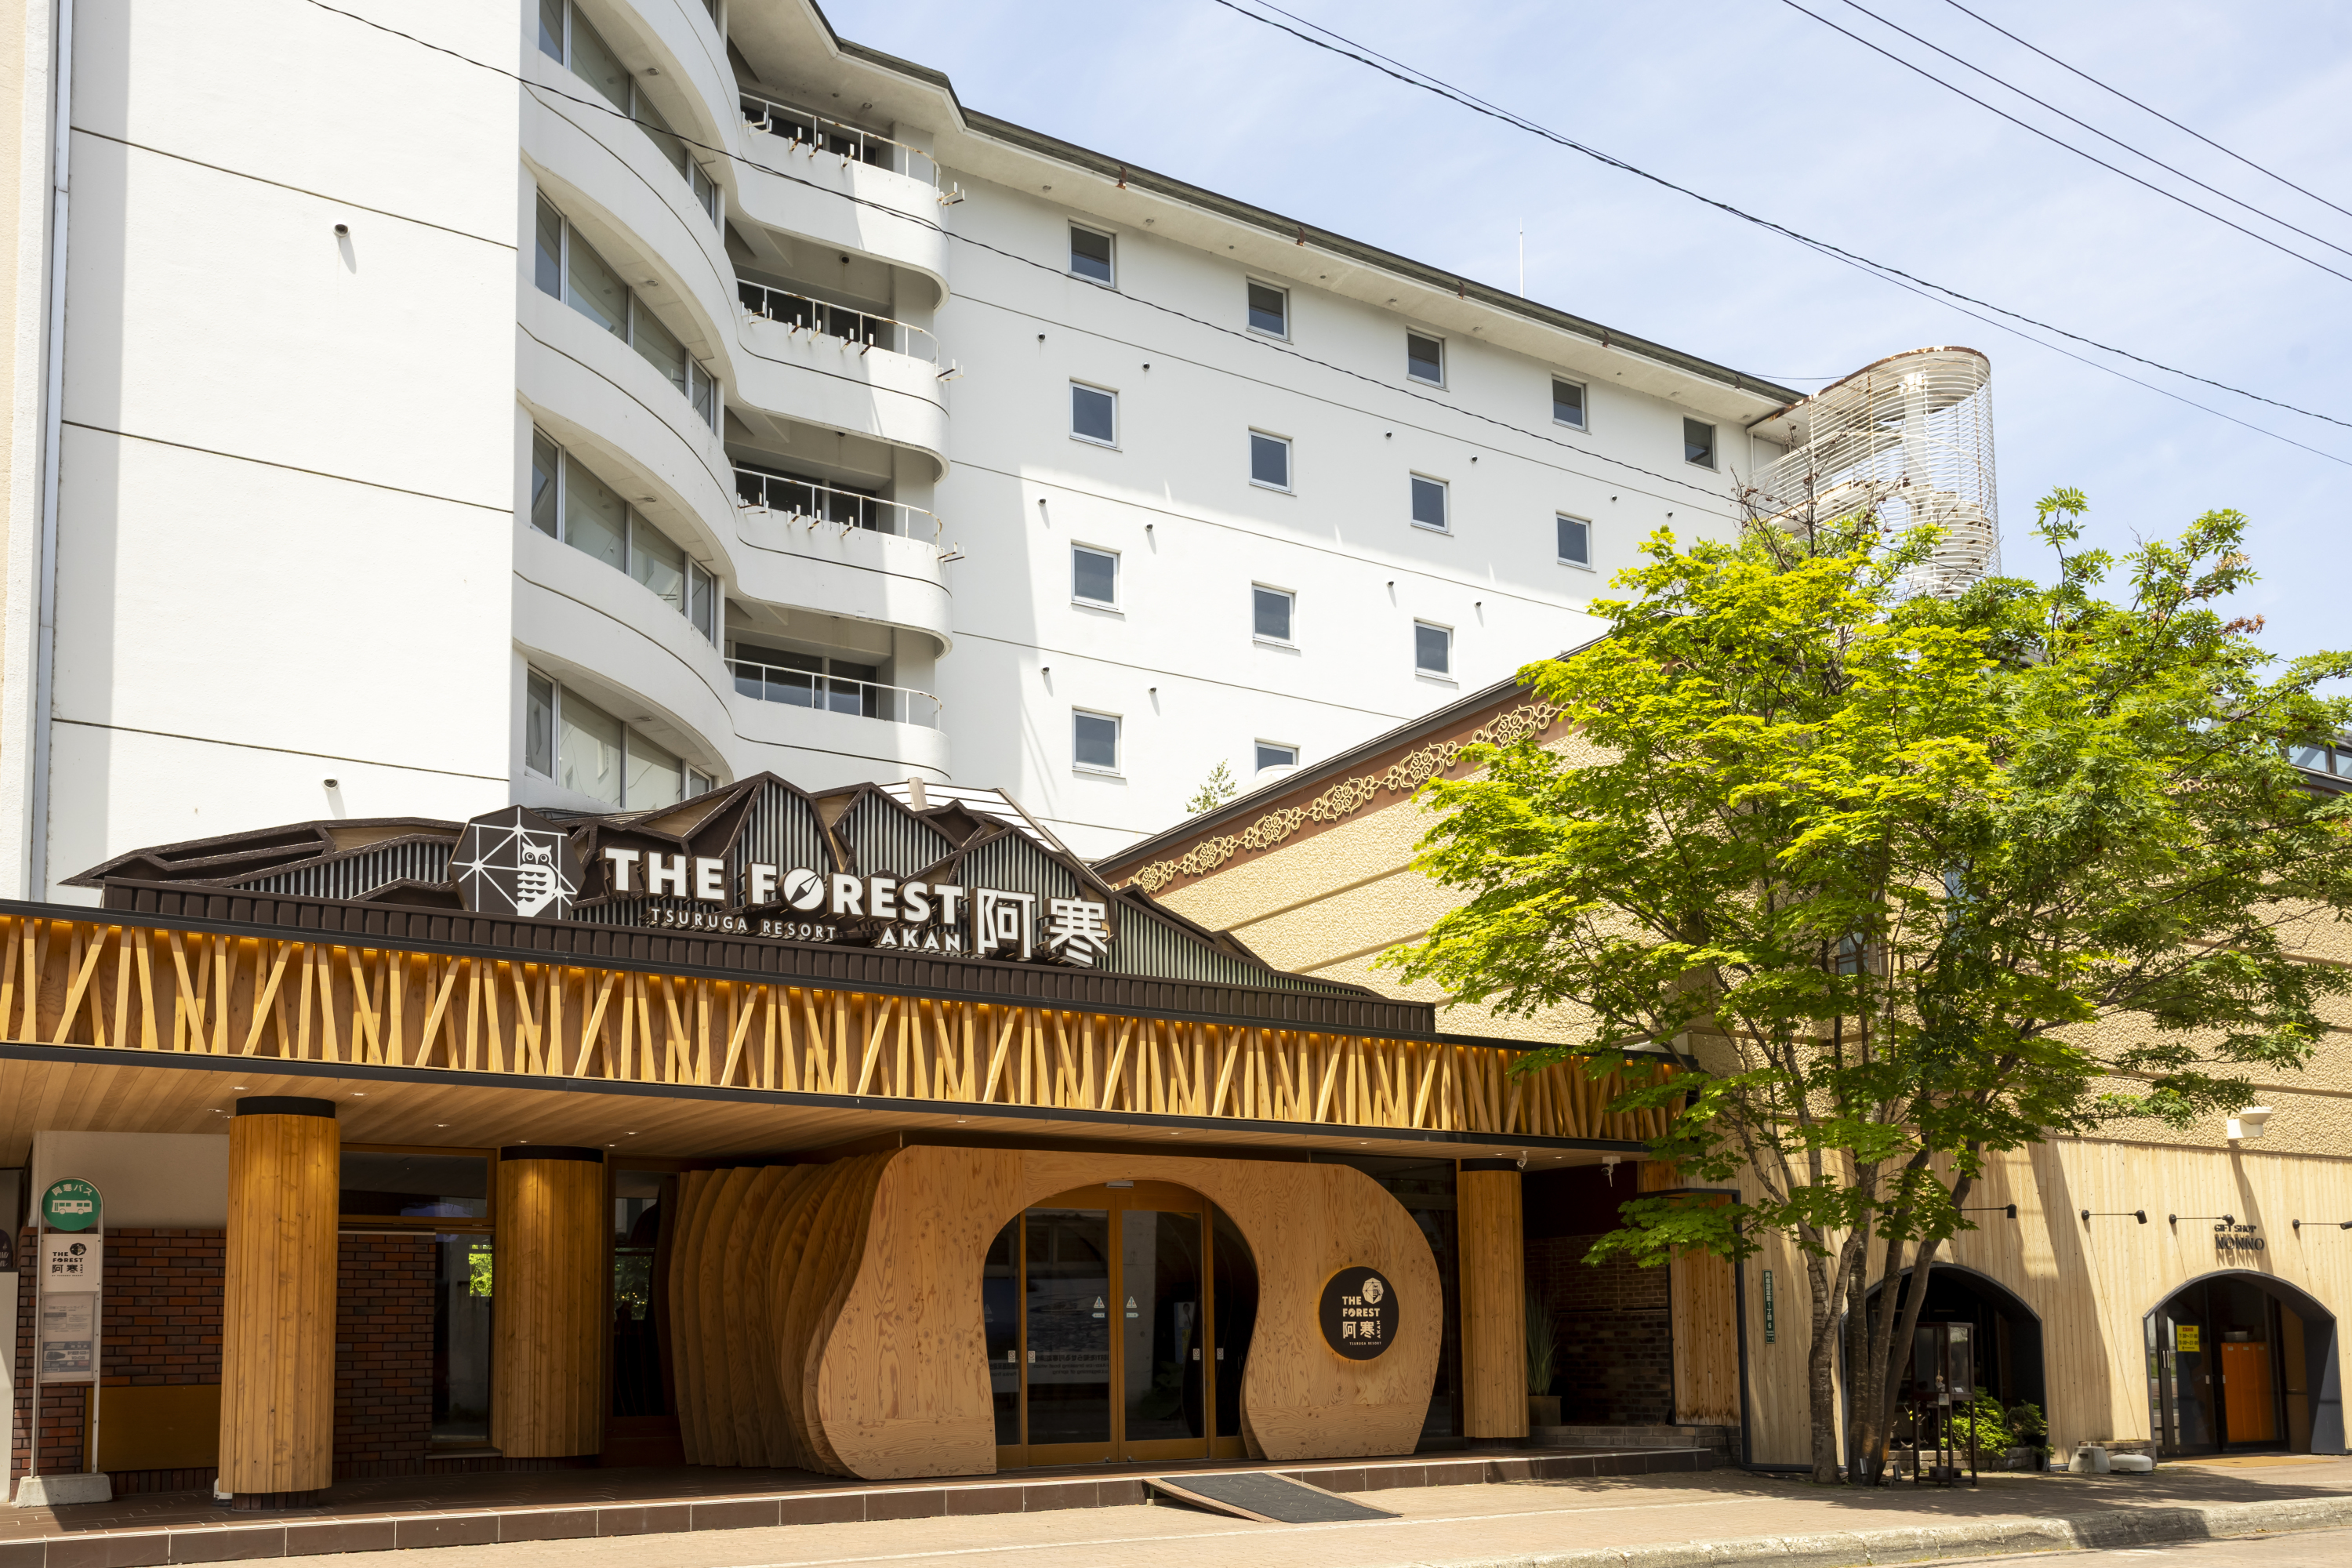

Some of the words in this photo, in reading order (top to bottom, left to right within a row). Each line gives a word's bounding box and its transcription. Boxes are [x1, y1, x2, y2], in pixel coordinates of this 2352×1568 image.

[602, 846, 726, 901] THE
[746, 862, 964, 926] FOREST
[651, 907, 748, 932] TSURUGA
[761, 919, 837, 939] RESORT
[973, 886, 1108, 966] 阿寒
[880, 926, 961, 953] AKAN
[52, 1184, 93, 1196] 阿寒バス
[2214, 1224, 2232, 1232] GIFT
[2215, 1236, 2265, 1250] NONNO
[52, 1264, 78, 1273] 阿寒
[1342, 1296, 1362, 1305] THE
[1342, 1308, 1380, 1317] FOREST
[1342, 1320, 1375, 1339] 阿寒
